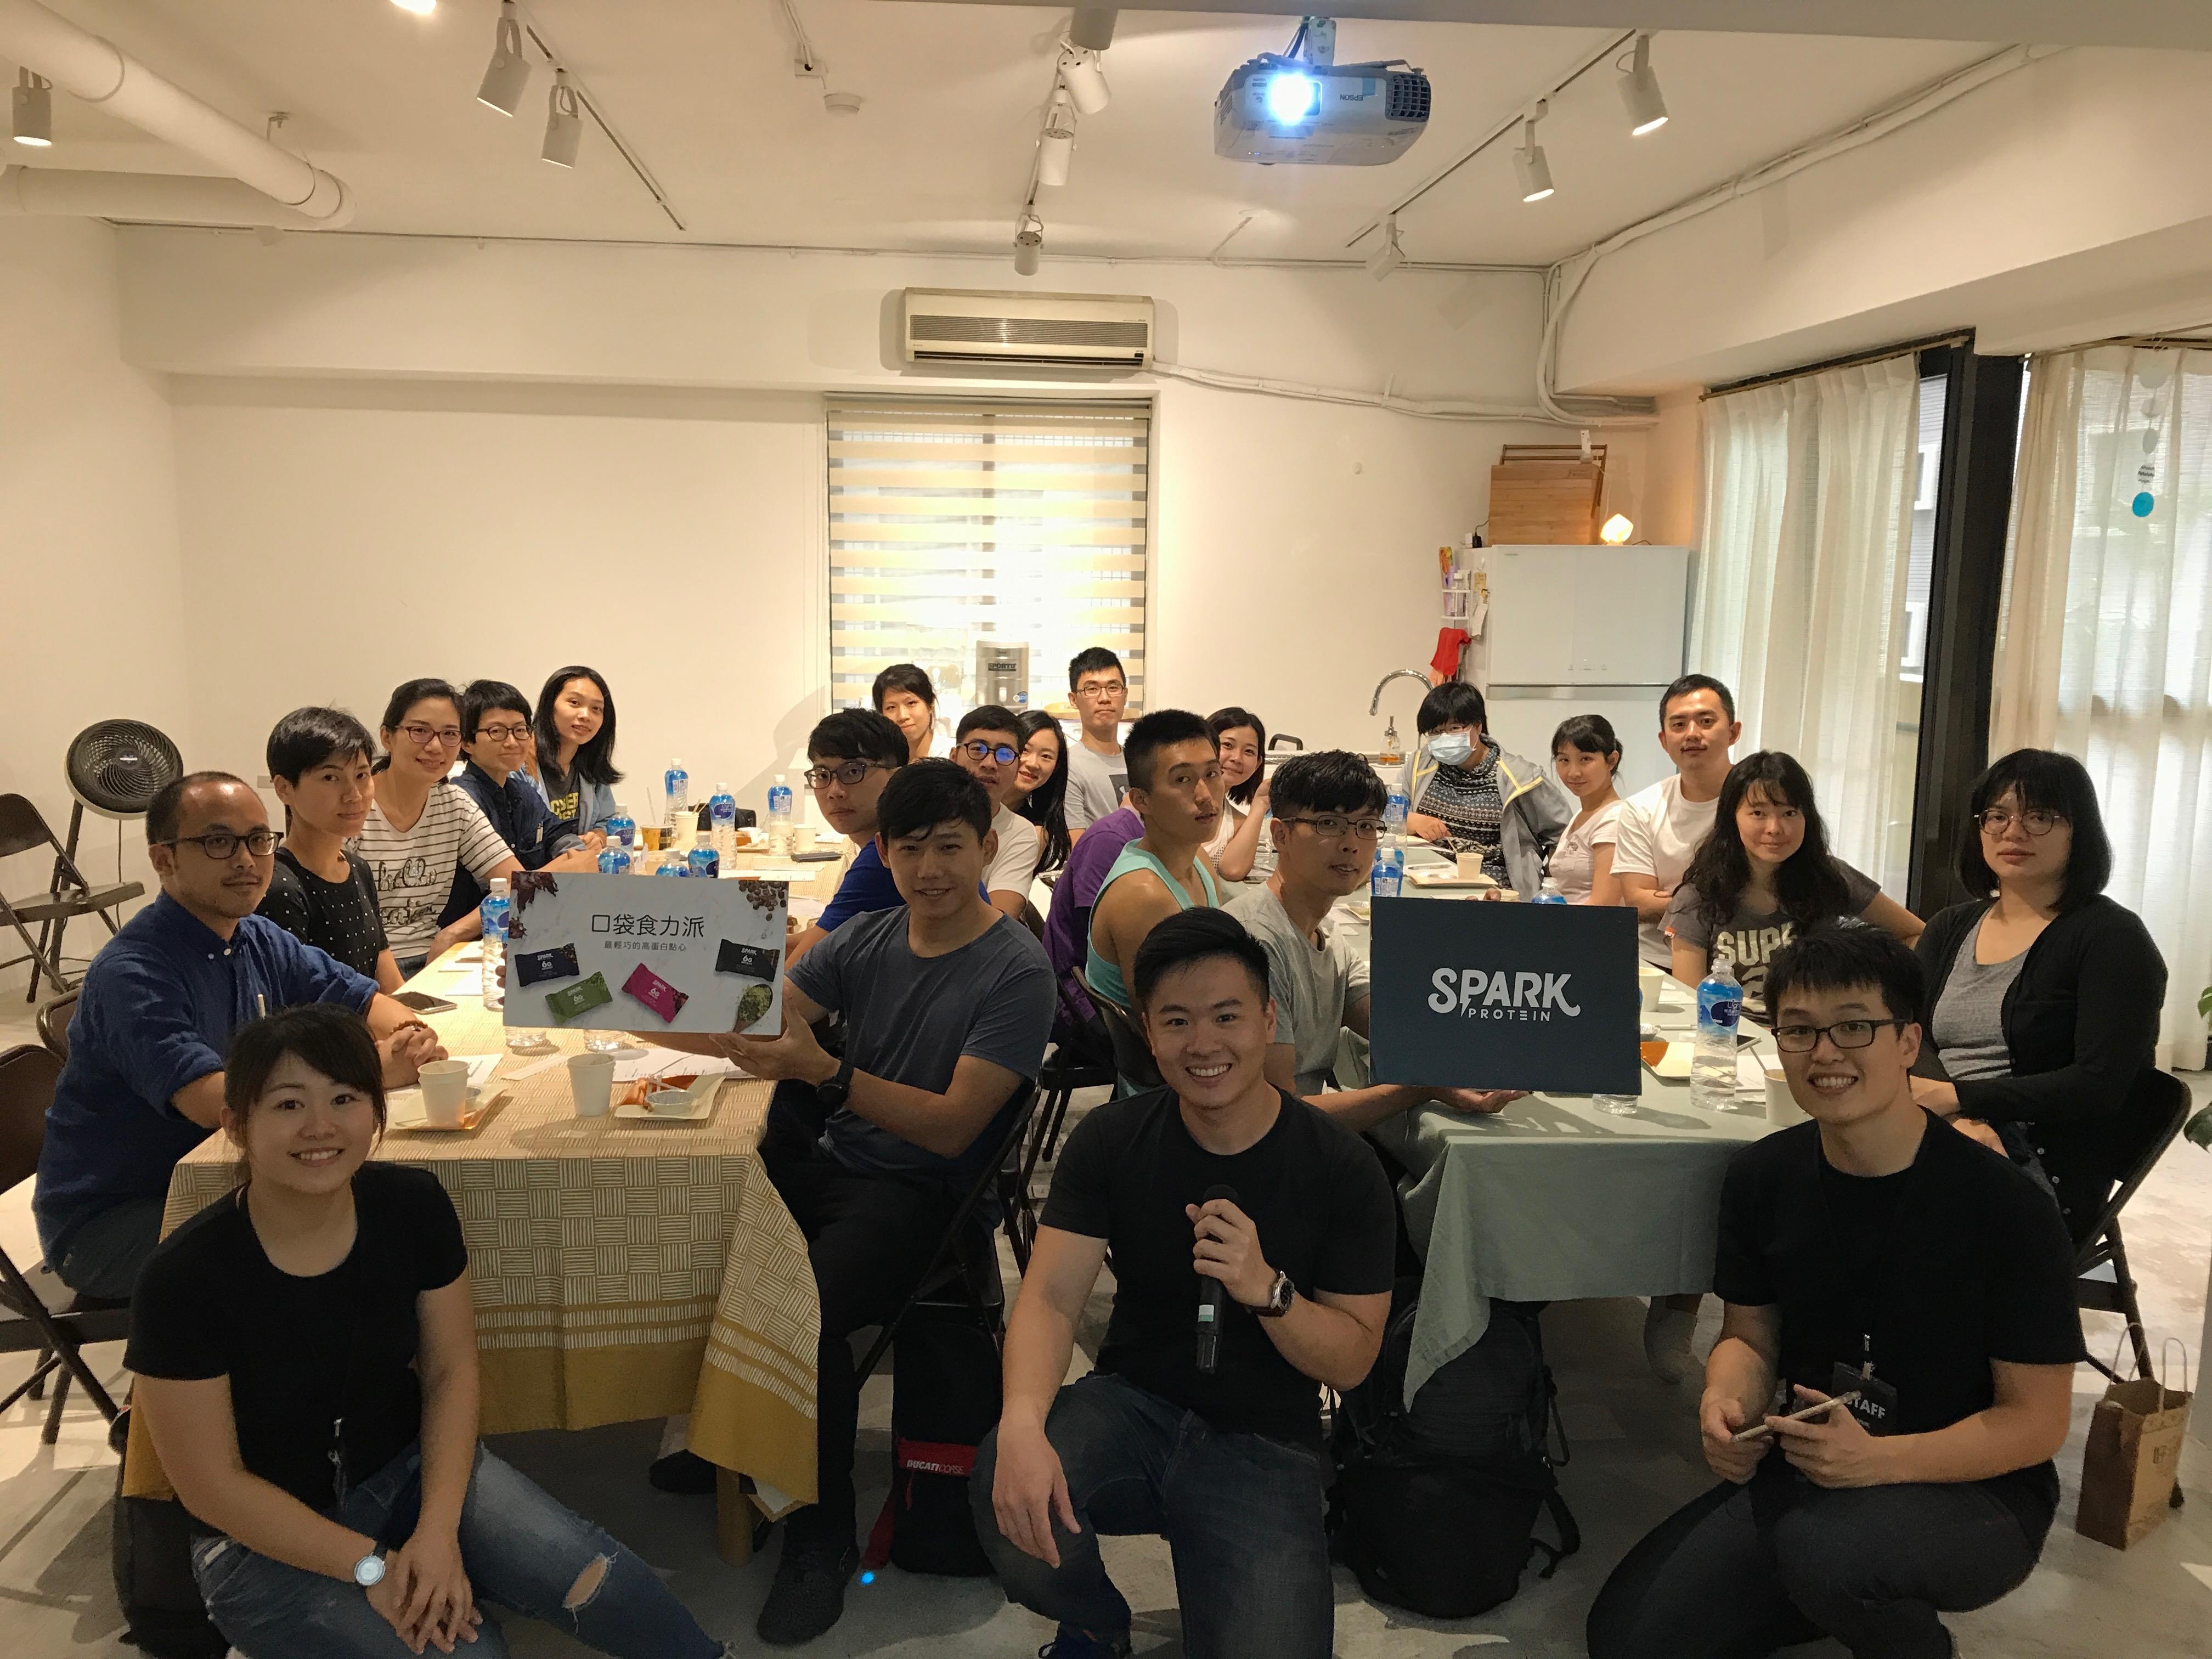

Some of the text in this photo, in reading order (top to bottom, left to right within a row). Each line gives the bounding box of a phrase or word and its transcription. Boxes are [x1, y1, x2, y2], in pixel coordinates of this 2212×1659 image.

[591, 913, 704, 938] 口袋食力派
[604, 940, 686, 951] 最輕巧的高蛋白點心
[741, 947, 757, 956] SPARK
[1427, 967, 1581, 1017] SPARK
[1468, 1008, 1550, 1022] PROTEIN
